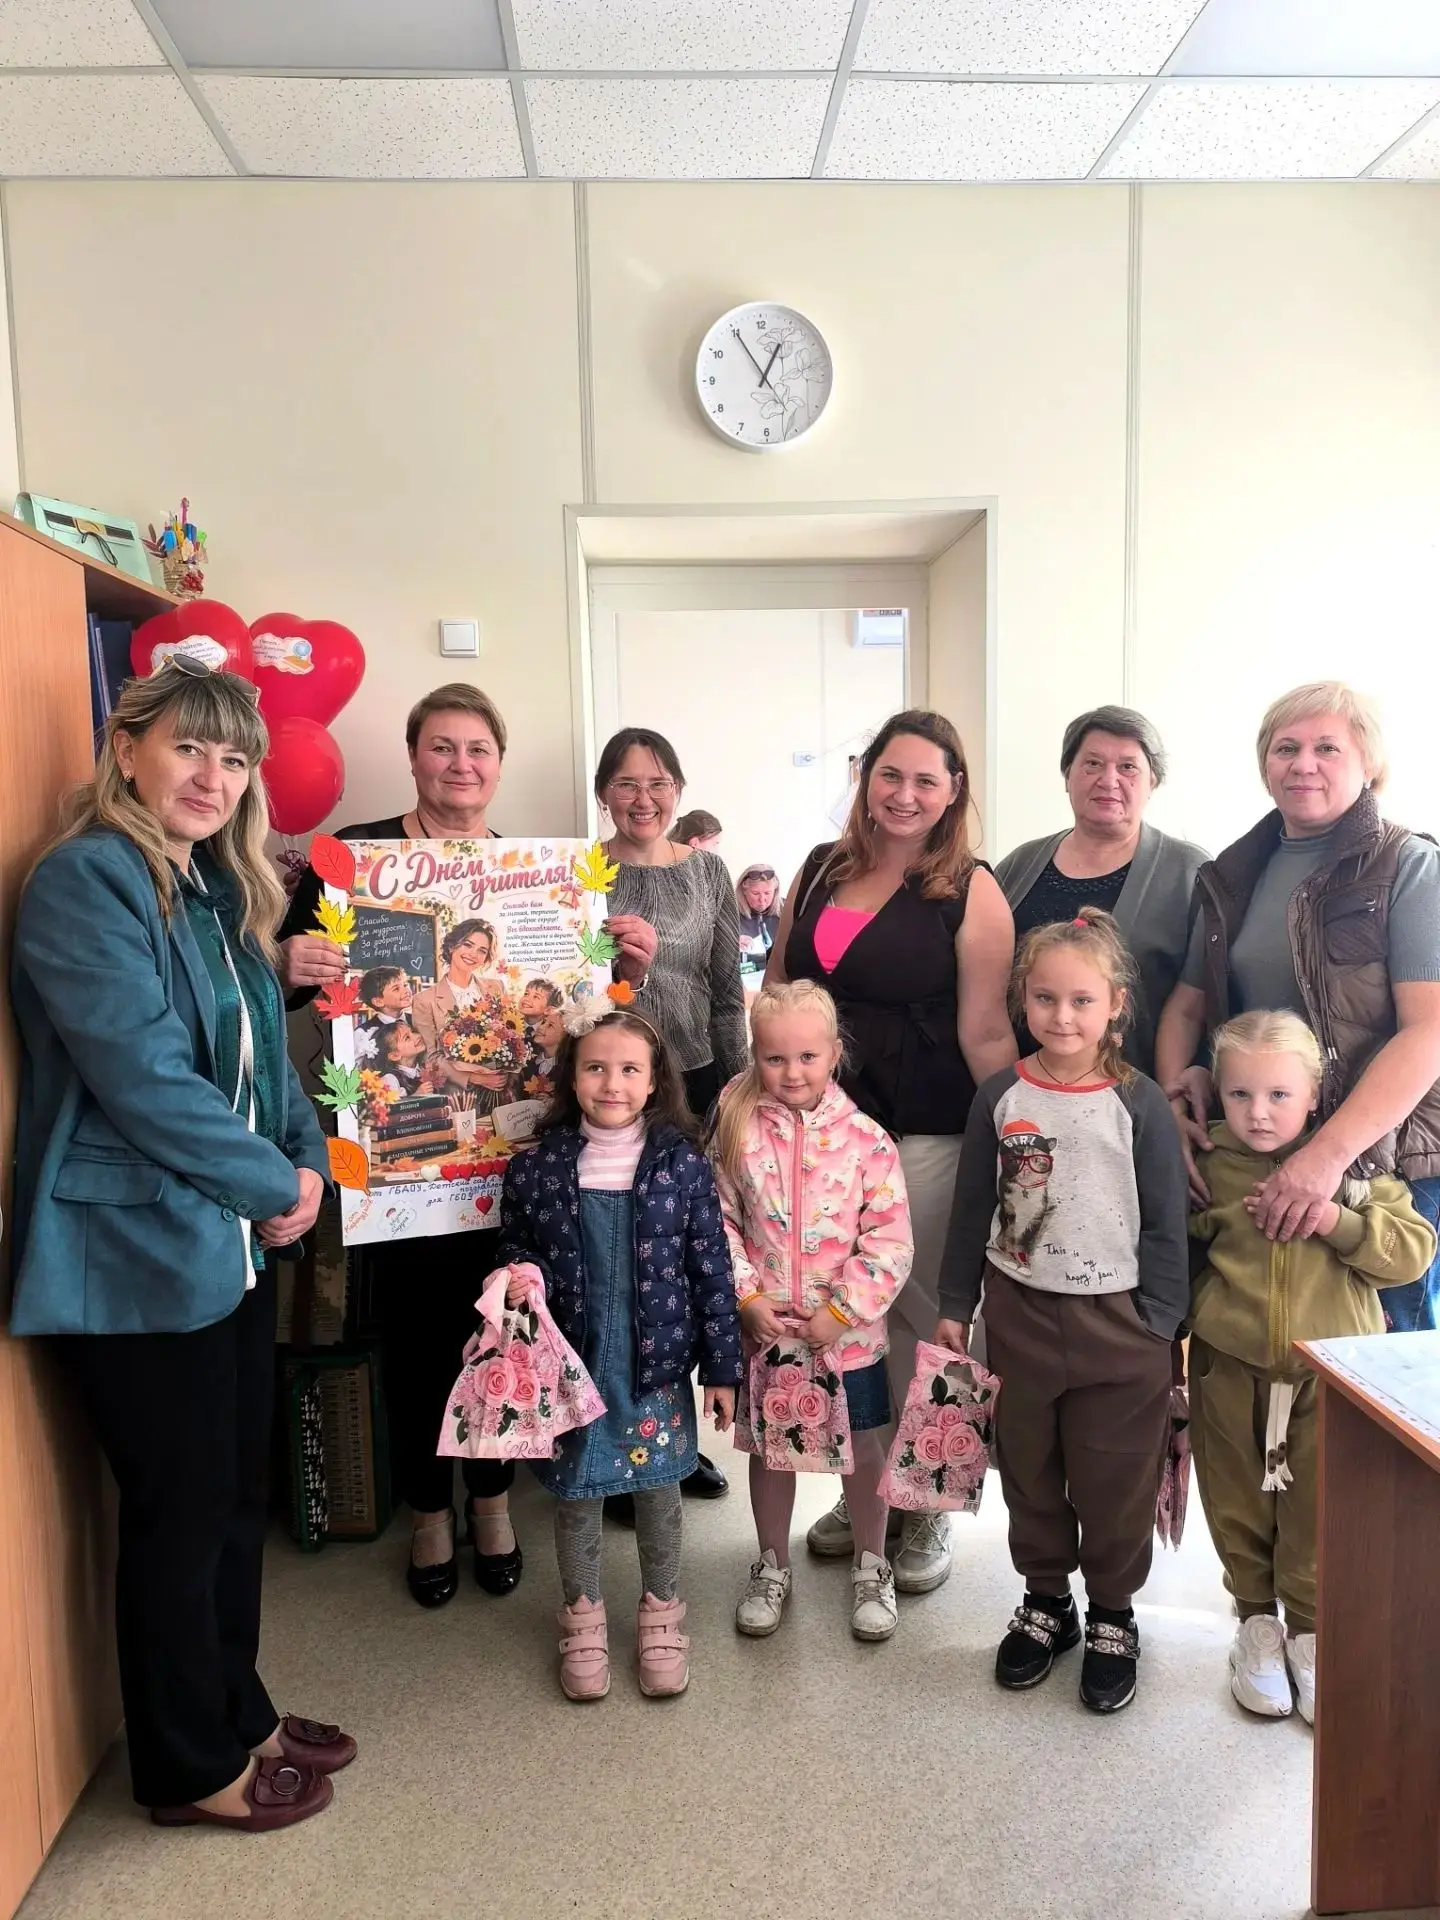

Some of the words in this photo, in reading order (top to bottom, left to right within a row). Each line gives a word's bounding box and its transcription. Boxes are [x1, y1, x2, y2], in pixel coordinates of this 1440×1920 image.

[756, 321, 765, 329] 12
[732, 329, 740, 337] 11
[712, 350, 723, 358] 10
[709, 376, 715, 384] 9
[718, 404, 724, 412] 8
[739, 422, 744, 431] 7
[764, 428, 769, 437] 6
[369, 854, 398, 900] С
[405, 852, 486, 893] Днём
[469, 855, 575, 910] учителя!
[358, 914, 390, 926] Спасибо
[1004, 1135, 1037, 1148] GIRL
[1043, 1243, 1066, 1255] This
[1083, 1259, 1097, 1272] my
[1065, 1272, 1091, 1287] happy
